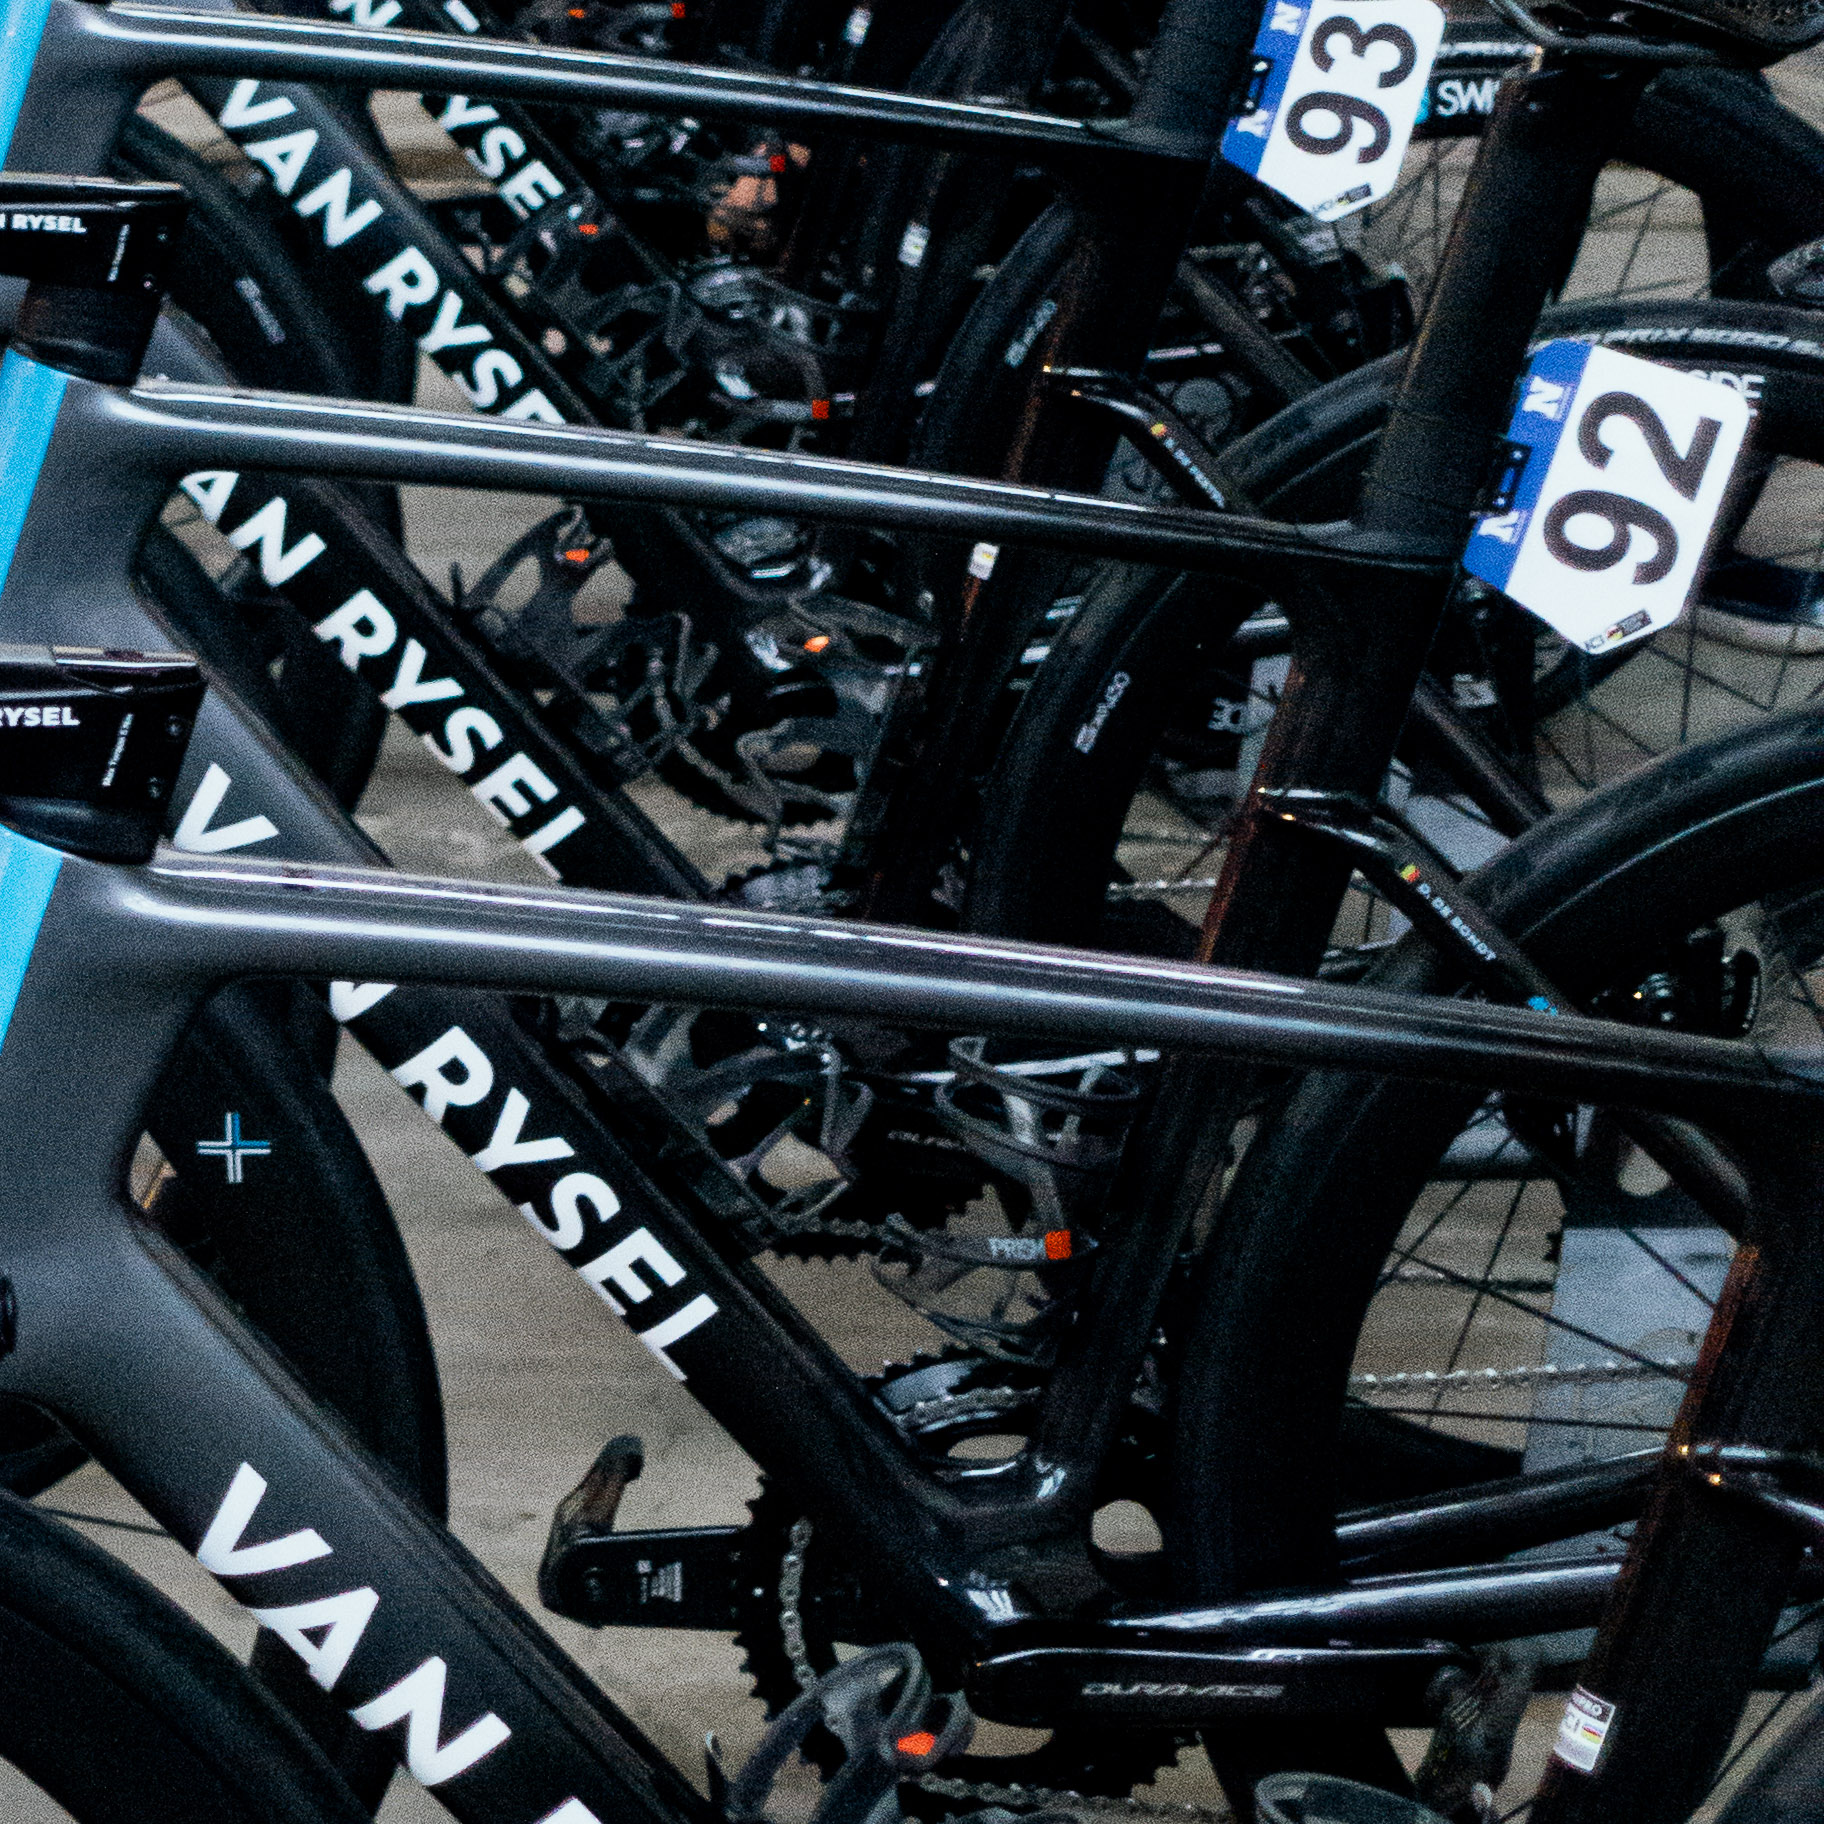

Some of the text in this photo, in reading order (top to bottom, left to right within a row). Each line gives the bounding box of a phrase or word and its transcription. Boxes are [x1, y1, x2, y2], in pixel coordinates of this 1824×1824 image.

[218, 77, 382, 249] VAN
[1284, 15, 1418, 165] 93
[11, 213, 87, 234] RYSEL
[1543, 390, 1723, 586] 92
[179, 470, 327, 587] AN
[315, 589, 586, 880] RYSEL
[390, 1025, 719, 1381] RYSEL
[197, 1462, 512, 1786] VAN
